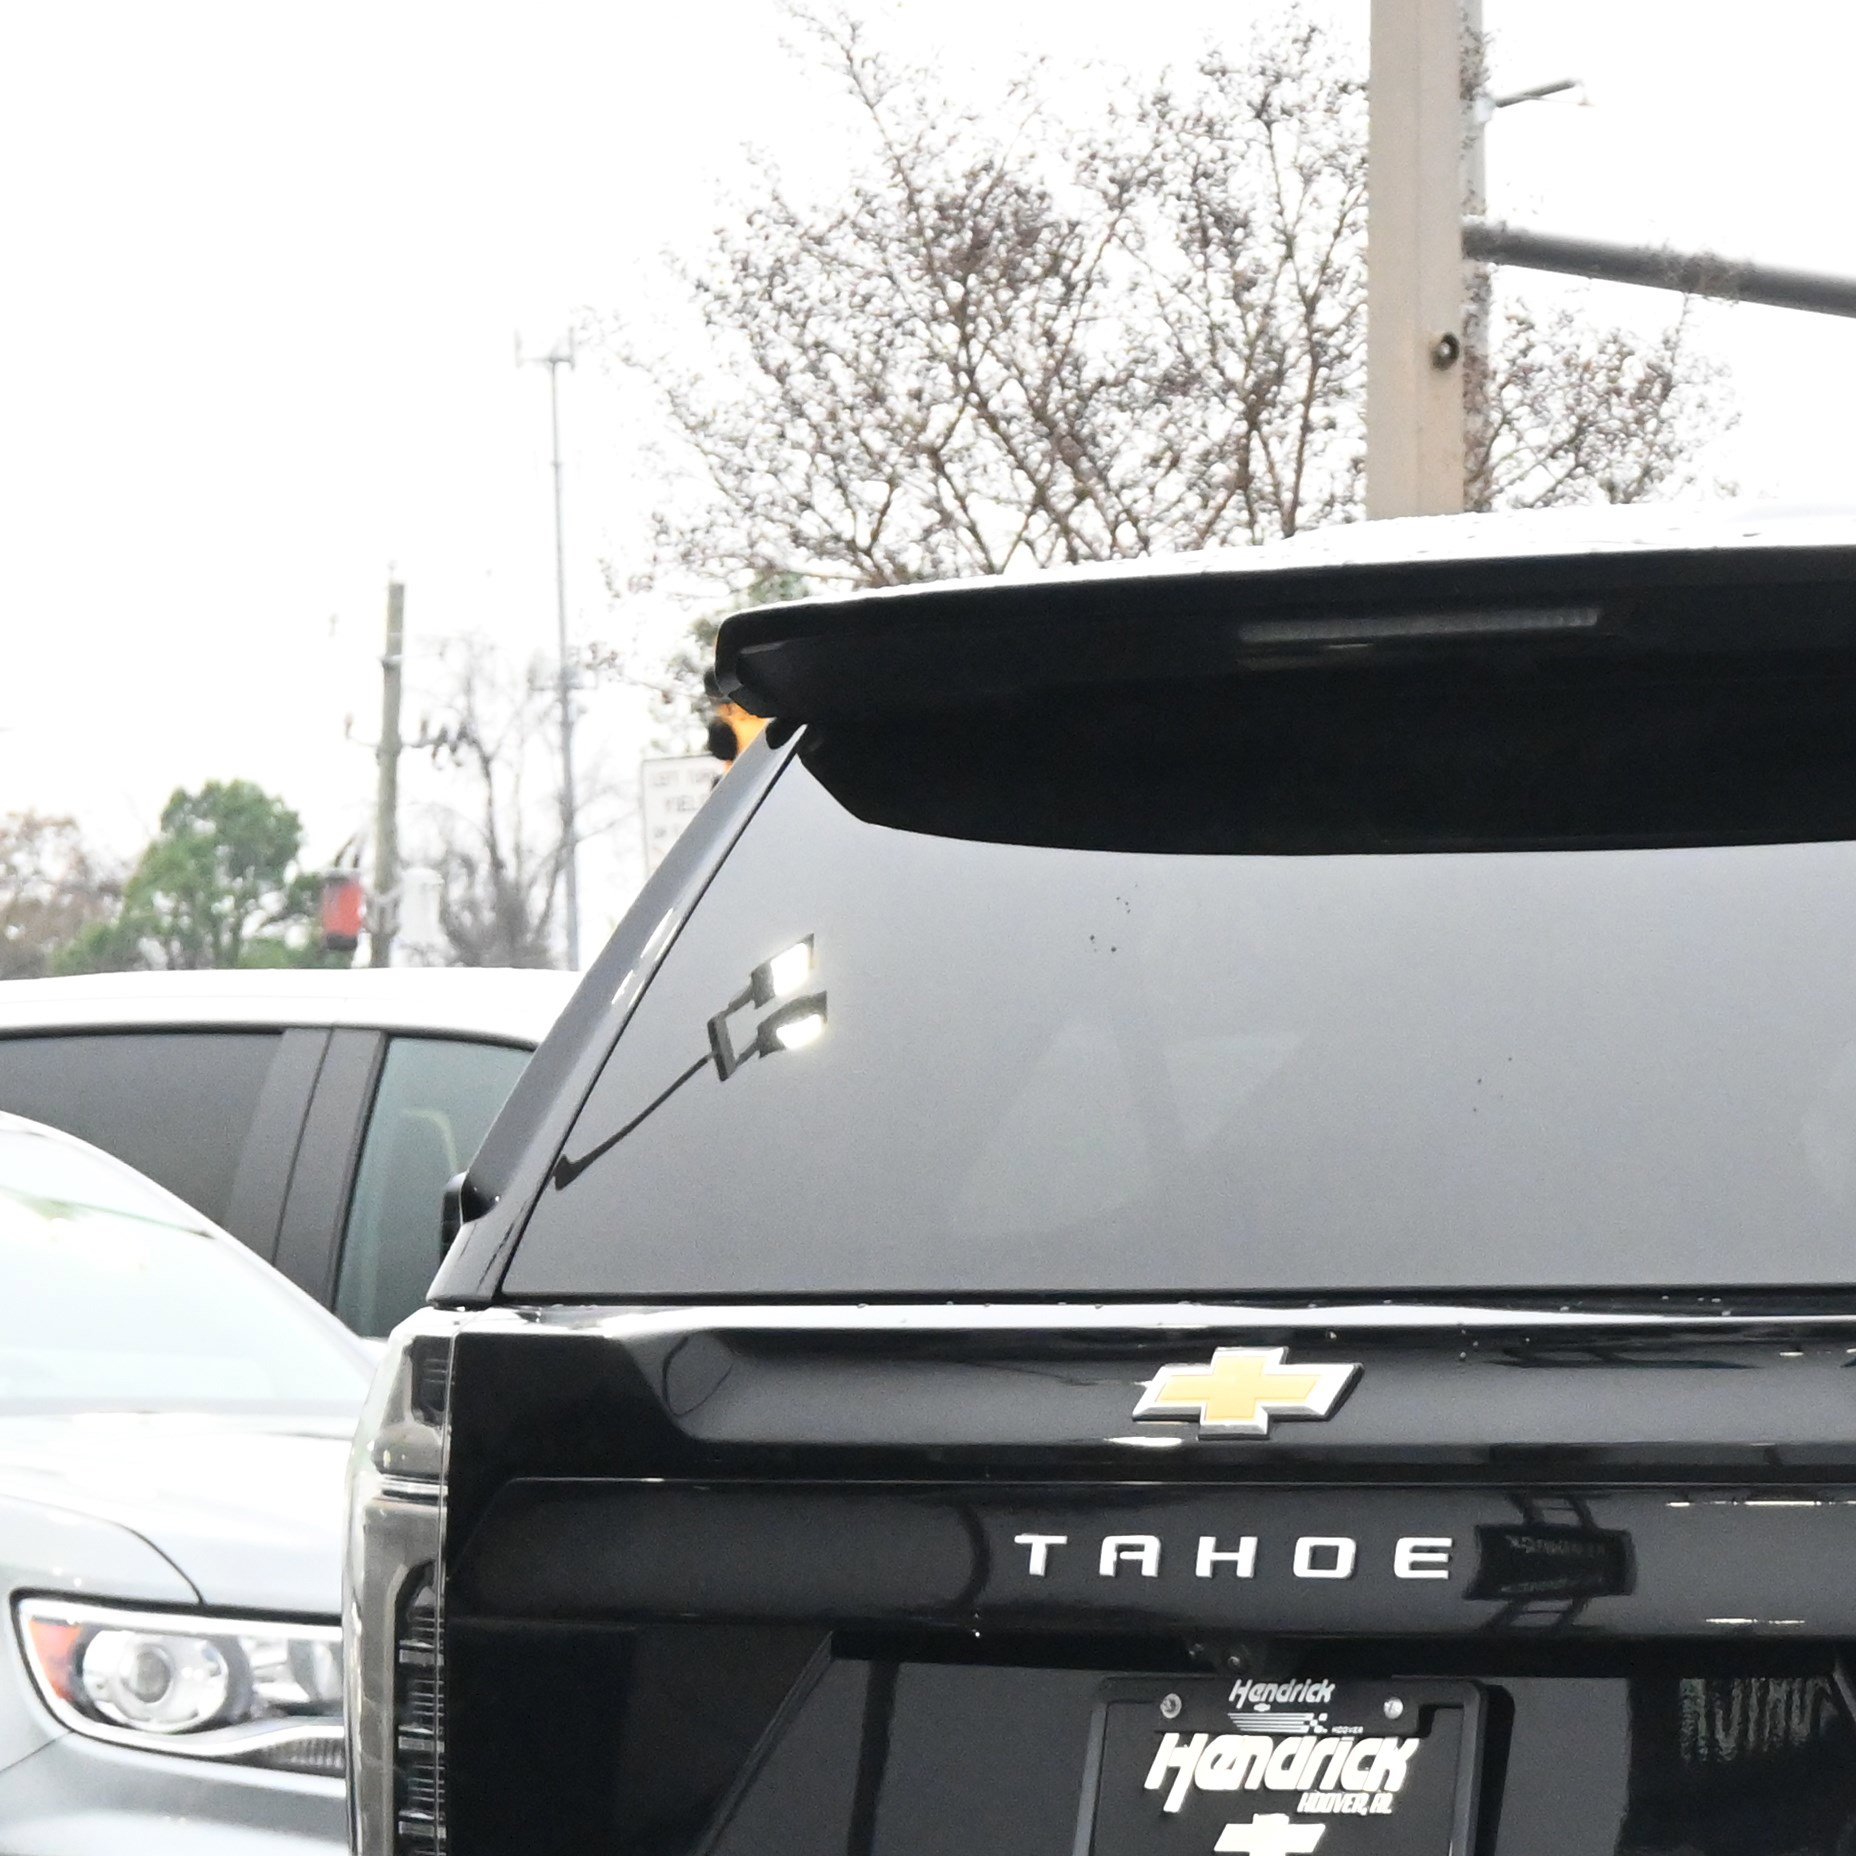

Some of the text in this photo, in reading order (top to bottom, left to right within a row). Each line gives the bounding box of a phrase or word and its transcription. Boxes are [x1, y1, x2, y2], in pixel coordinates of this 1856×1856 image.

[1013, 1533, 1454, 1579] TAHOE
[1228, 1678, 1336, 1709] Hendrick
[1143, 1732, 1420, 1813] Hendrick
